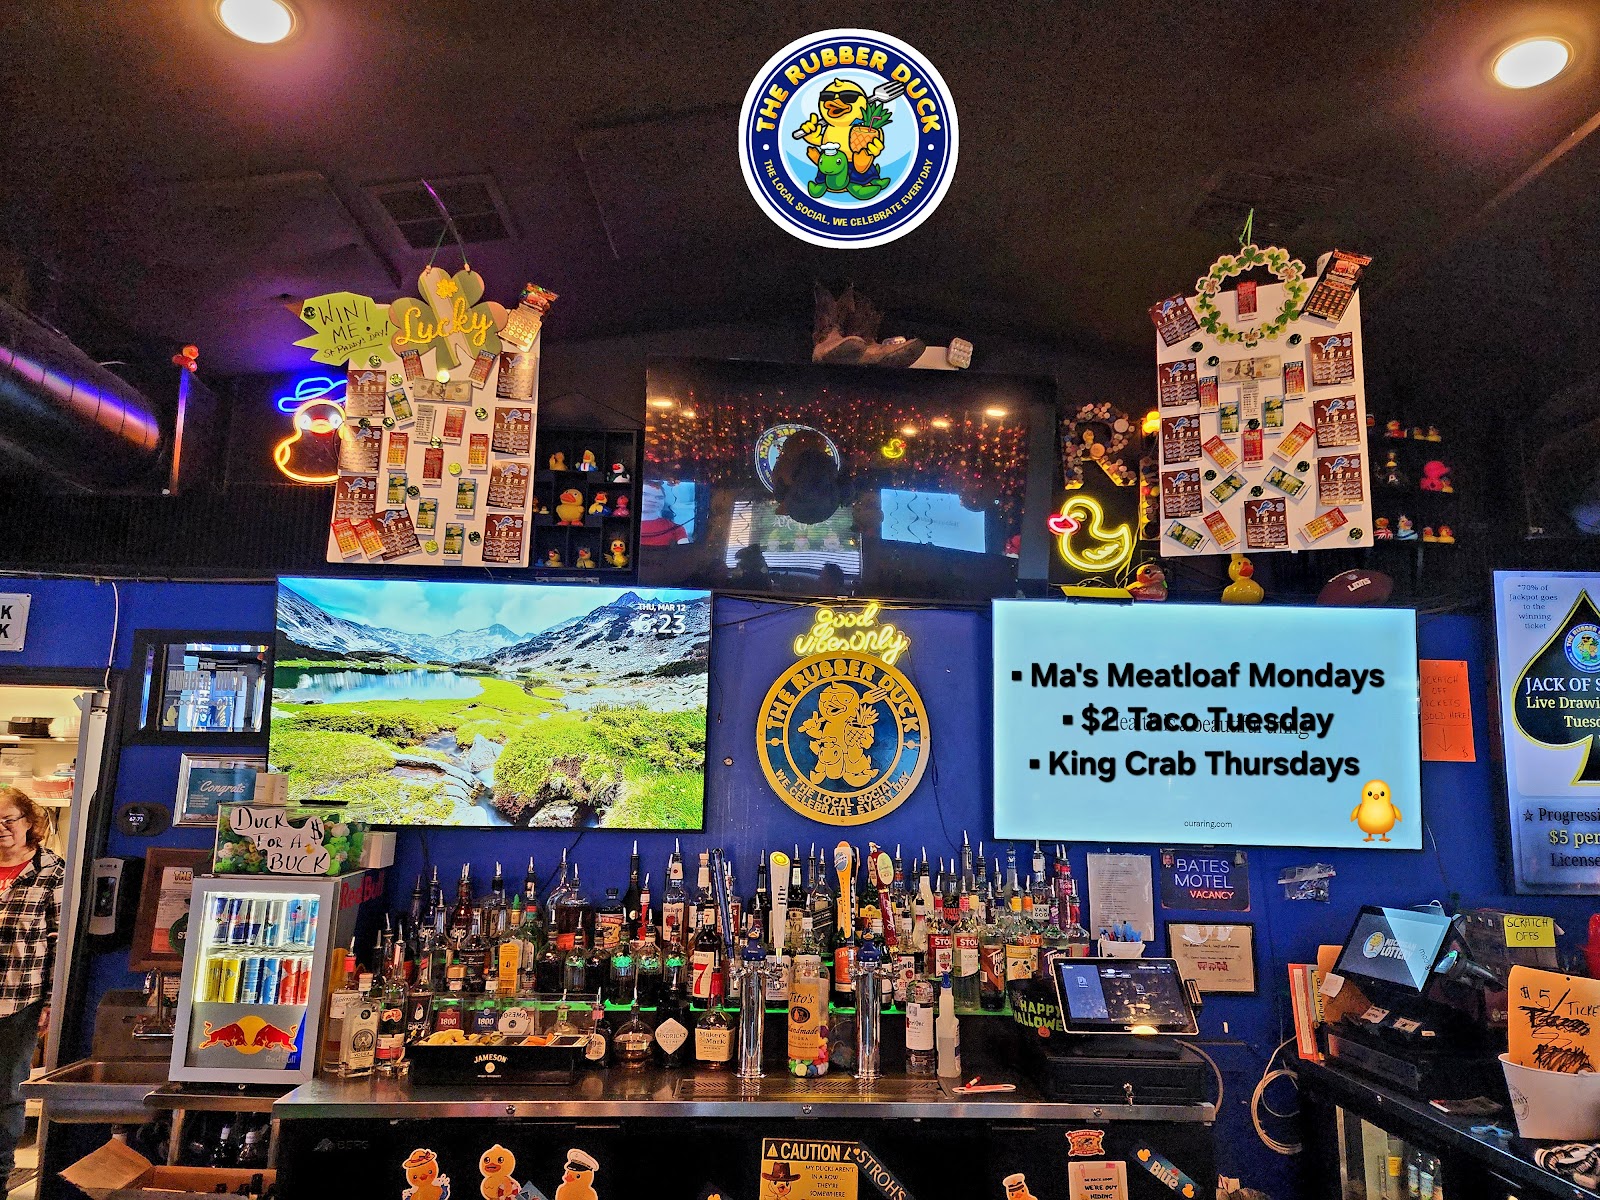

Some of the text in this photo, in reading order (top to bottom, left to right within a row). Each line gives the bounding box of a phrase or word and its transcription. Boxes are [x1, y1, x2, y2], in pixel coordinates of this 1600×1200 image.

[318, 298, 370, 331] WIN!
[395, 296, 494, 347] Lucky
[333, 322, 360, 344] ME
[1347, 578, 1371, 592] LIONS
[1509, 594, 1538, 602] Jackpot
[638, 604, 656, 612] THU,
[813, 603, 878, 637] good
[1519, 613, 1552, 621] winning
[795, 627, 850, 654] vibes
[1422, 674, 1459, 685] SCRATCH
[1525, 677, 1591, 695] JACK OF
[767, 659, 921, 733] THE RUBBER DUCK
[1431, 687, 1447, 695] OFF
[1526, 696, 1556, 708] Live
[1424, 712, 1446, 721] SOLD
[200, 780, 246, 796] Congrats
[775, 768, 911, 816] WE CELEBRATE EVERY DAY
[794, 778, 896, 807] THE LOCAL SOCIAL
[290, 834, 302, 849] A
[1549, 830, 1569, 845] $5
[269, 852, 329, 873] BUCK
[1177, 858, 1230, 873] BATES
[1175, 874, 1234, 889] MOTEL
[340, 881, 362, 910] Red
[1189, 890, 1234, 900] VACANCY
[704, 914, 710, 923] 7
[1507, 917, 1548, 928] SCRATCH
[1515, 931, 1539, 942] OFFS
[693, 963, 709, 994] 7
[790, 992, 815, 1004] Tito's
[1021, 1000, 1061, 1016] HAPPY
[440, 1017, 456, 1026] 1800
[477, 1017, 494, 1026] 1800
[473, 1053, 508, 1063] JAMESON
[780, 1142, 841, 1161] CAUTION
[857, 1150, 907, 1200] STROH'S
[1150, 1160, 1179, 1190] Blue
